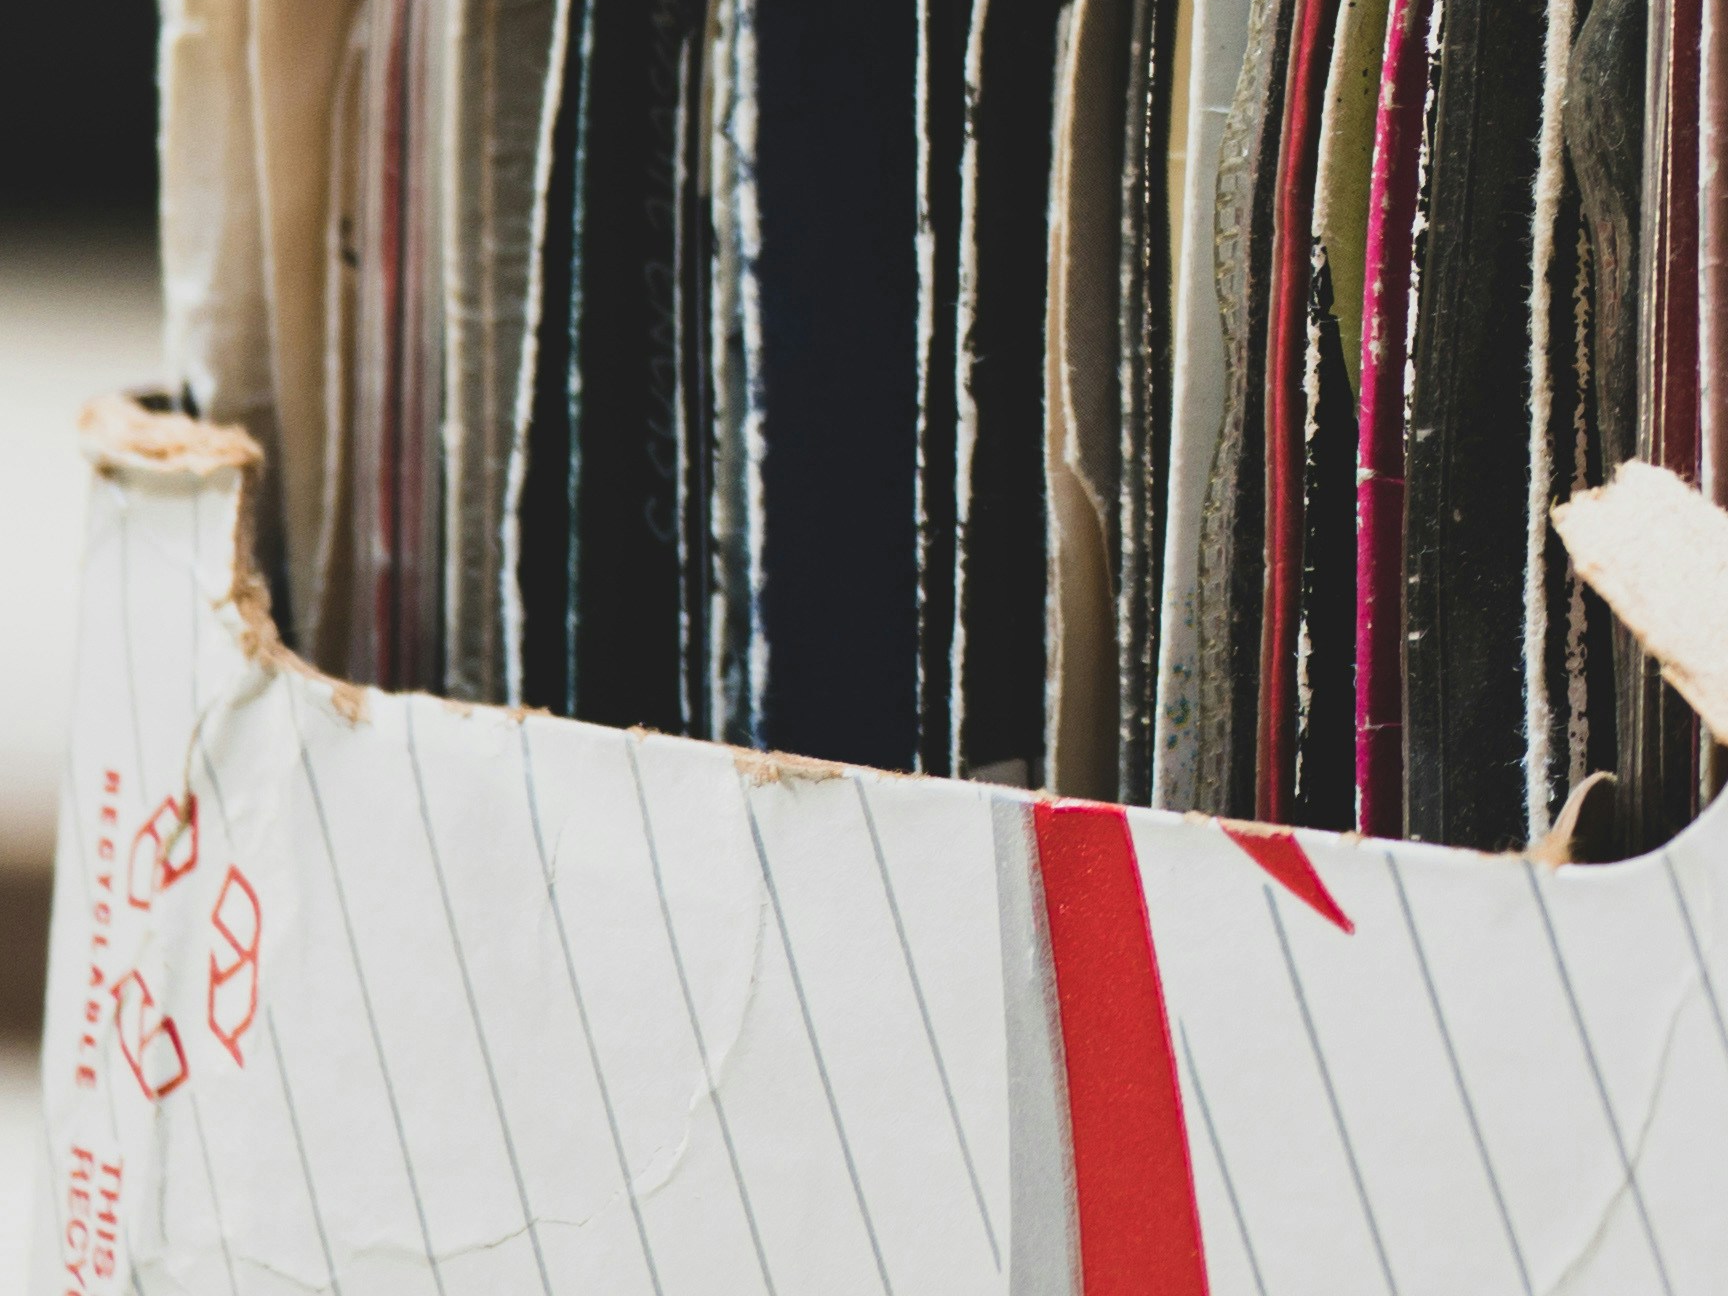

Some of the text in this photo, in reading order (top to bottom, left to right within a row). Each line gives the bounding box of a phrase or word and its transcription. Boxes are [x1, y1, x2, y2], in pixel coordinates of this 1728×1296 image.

[76, 769, 121, 1089] RECYCLABLE
[63, 1141, 95, 1296] RECY
[93, 1156, 123, 1280] THIS
